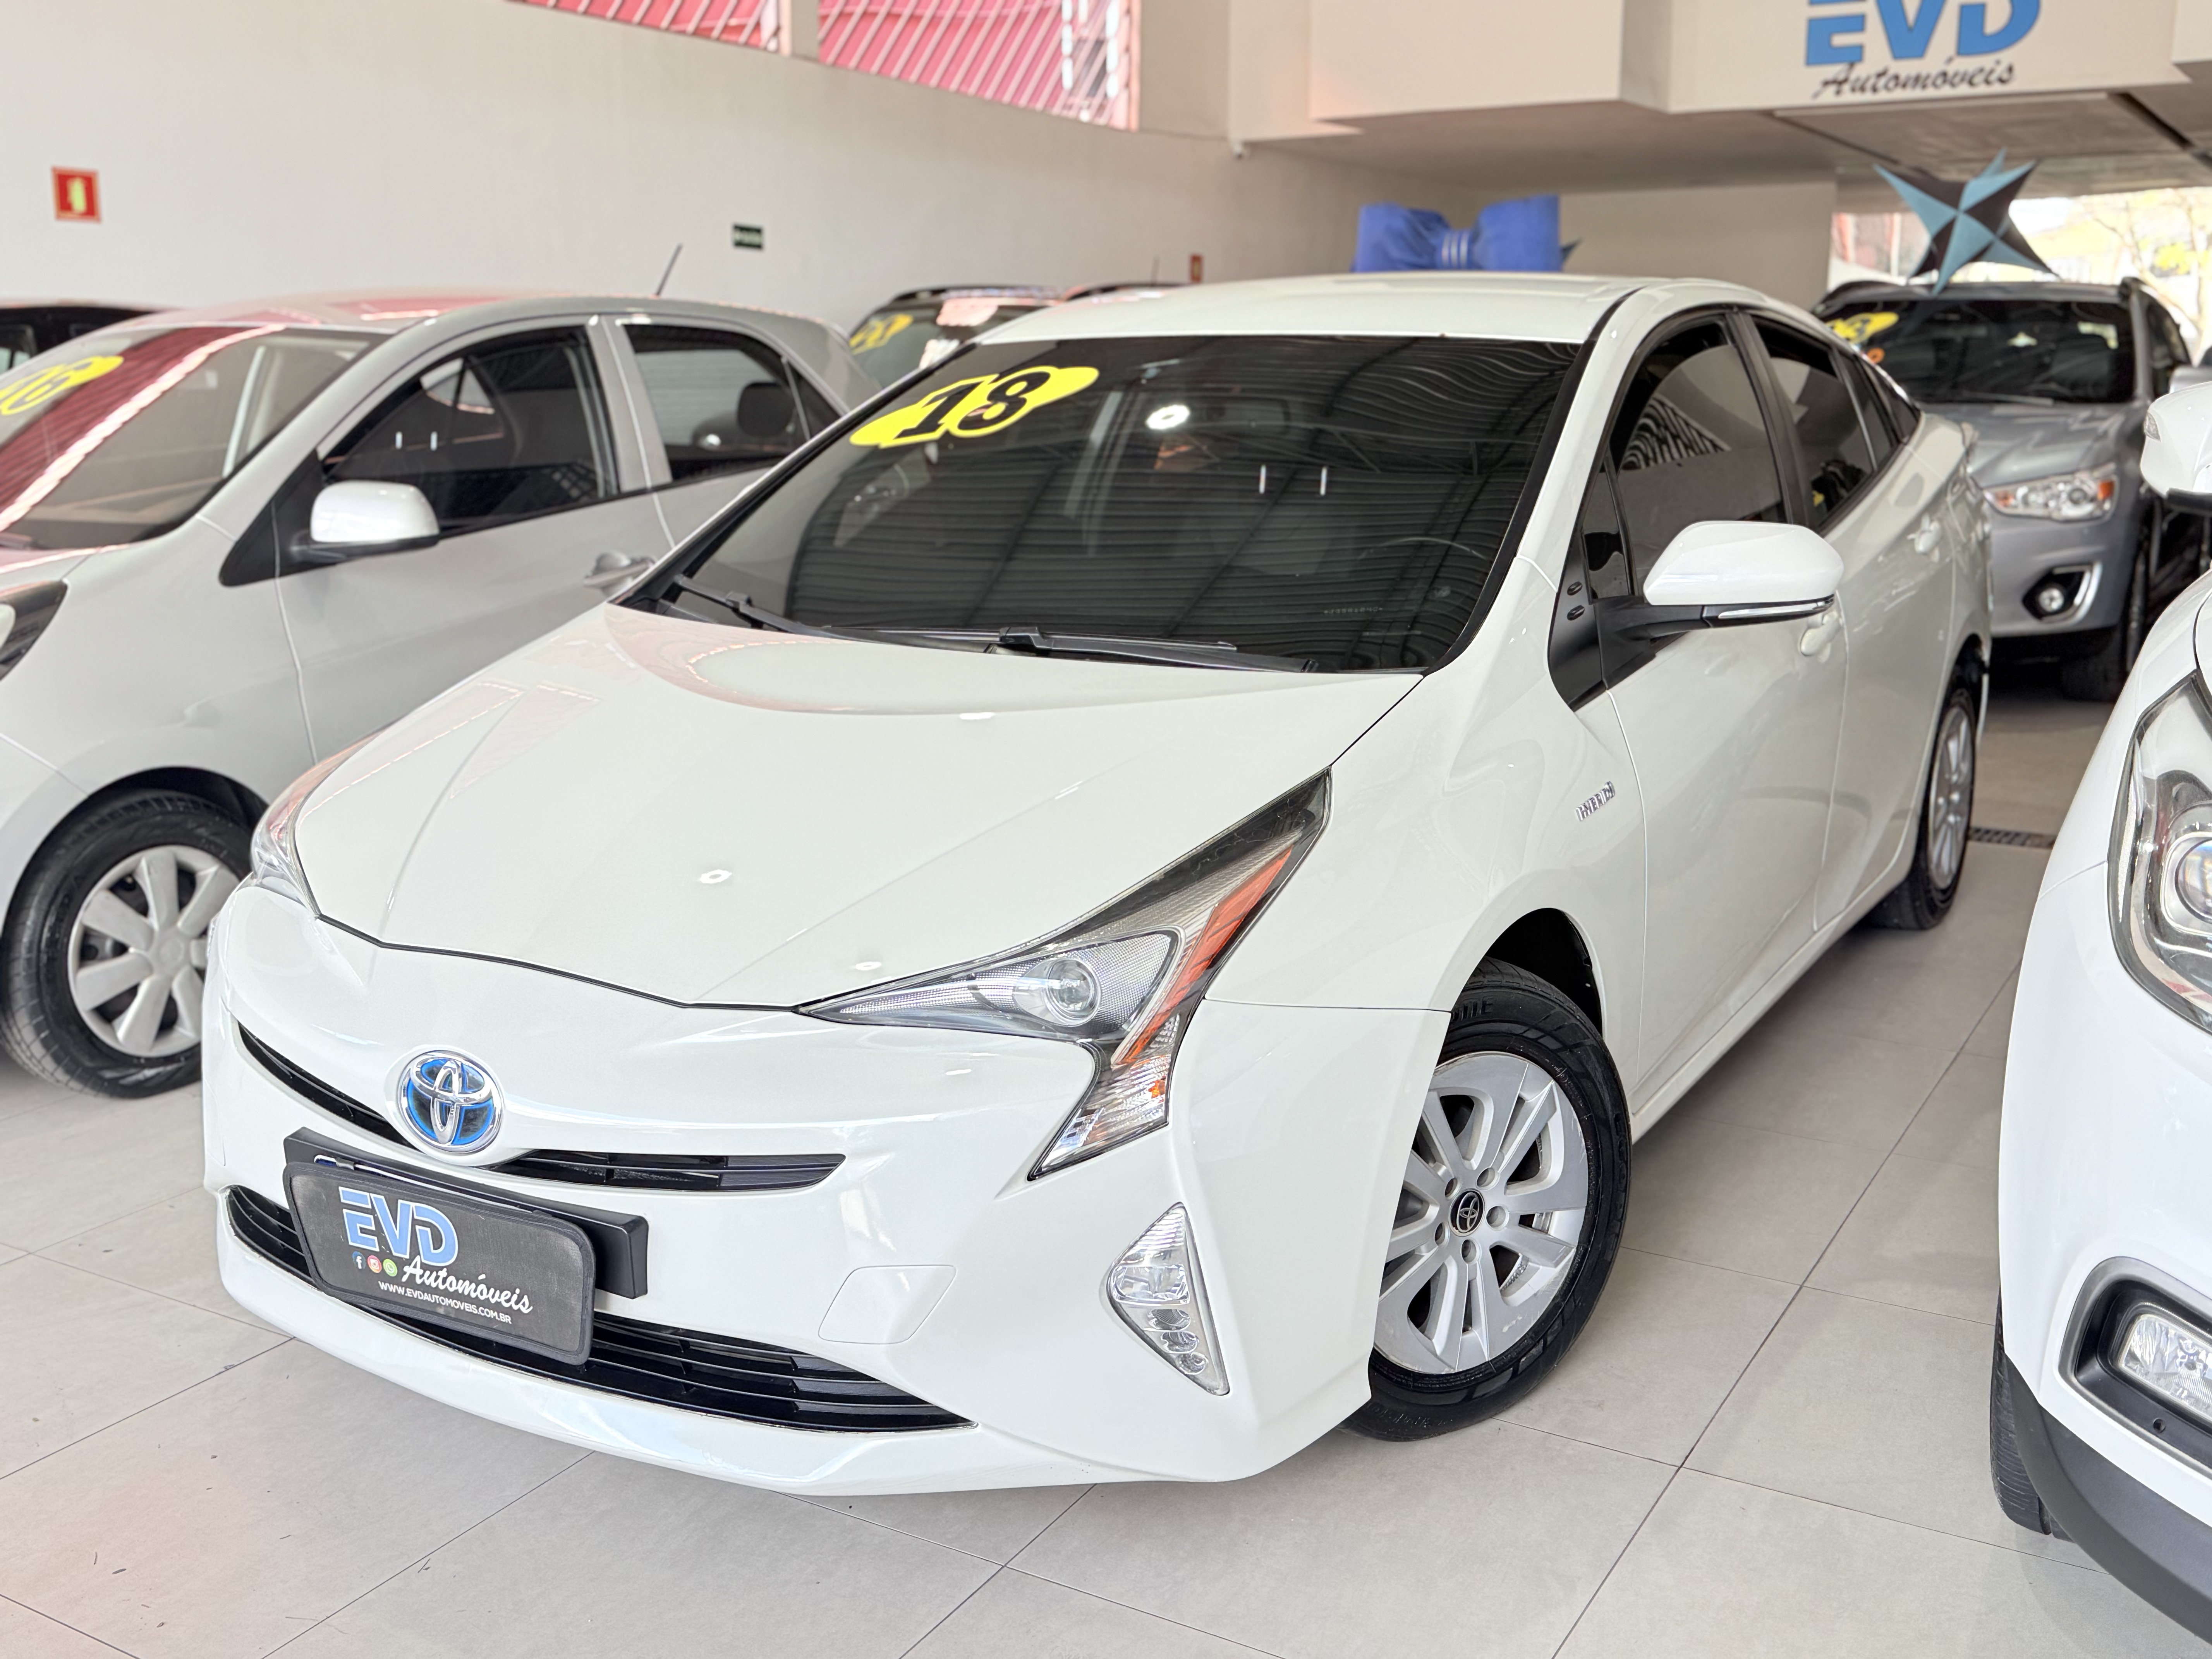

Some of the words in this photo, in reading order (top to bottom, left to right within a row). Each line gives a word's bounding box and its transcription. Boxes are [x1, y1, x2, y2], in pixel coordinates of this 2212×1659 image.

[1805, 0, 2040, 66] EVD
[1812, 56, 2015, 99] Automóveis
[893, 371, 1051, 440] 18
[338, 1186, 459, 1266] EVD
[378, 1281, 512, 1324] WWW.EVDAUTOMOVEIS.COM.BR
[402, 1255, 533, 1313] Automóveis
